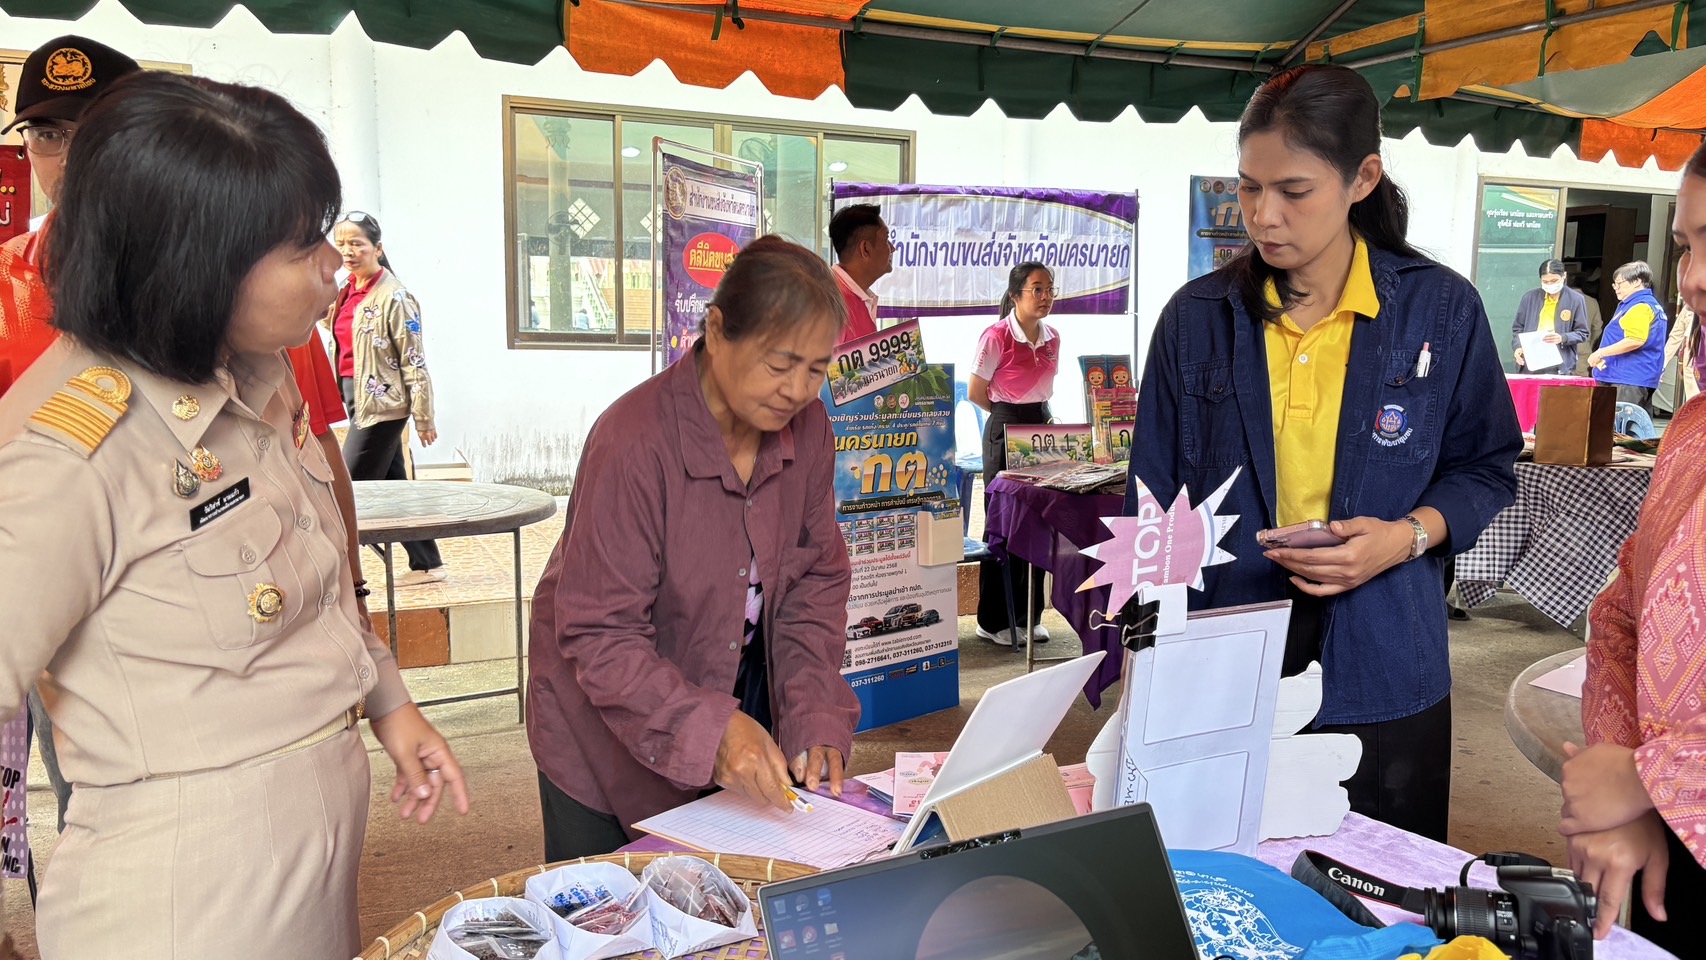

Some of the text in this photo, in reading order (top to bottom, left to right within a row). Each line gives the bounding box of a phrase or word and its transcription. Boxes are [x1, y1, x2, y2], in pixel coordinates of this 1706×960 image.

[1215, 201, 1241, 227] ก
[890, 231, 1130, 268] ำนักงานขนส่งจังหวัดนครนายก
[675, 292, 709, 313] รับปรึกษ
[838, 331, 912, 375] กต 9999
[835, 431, 919, 451] นครนายก
[1031, 433, 1072, 452] กต 1
[860, 451, 928, 494] กต
[1163, 501, 1176, 585] ambon One Produ
[848, 586, 908, 602] ด้จากการประมูลนำเข้า
[0, 766, 20, 789] OP
[1328, 867, 1385, 897] Canon
